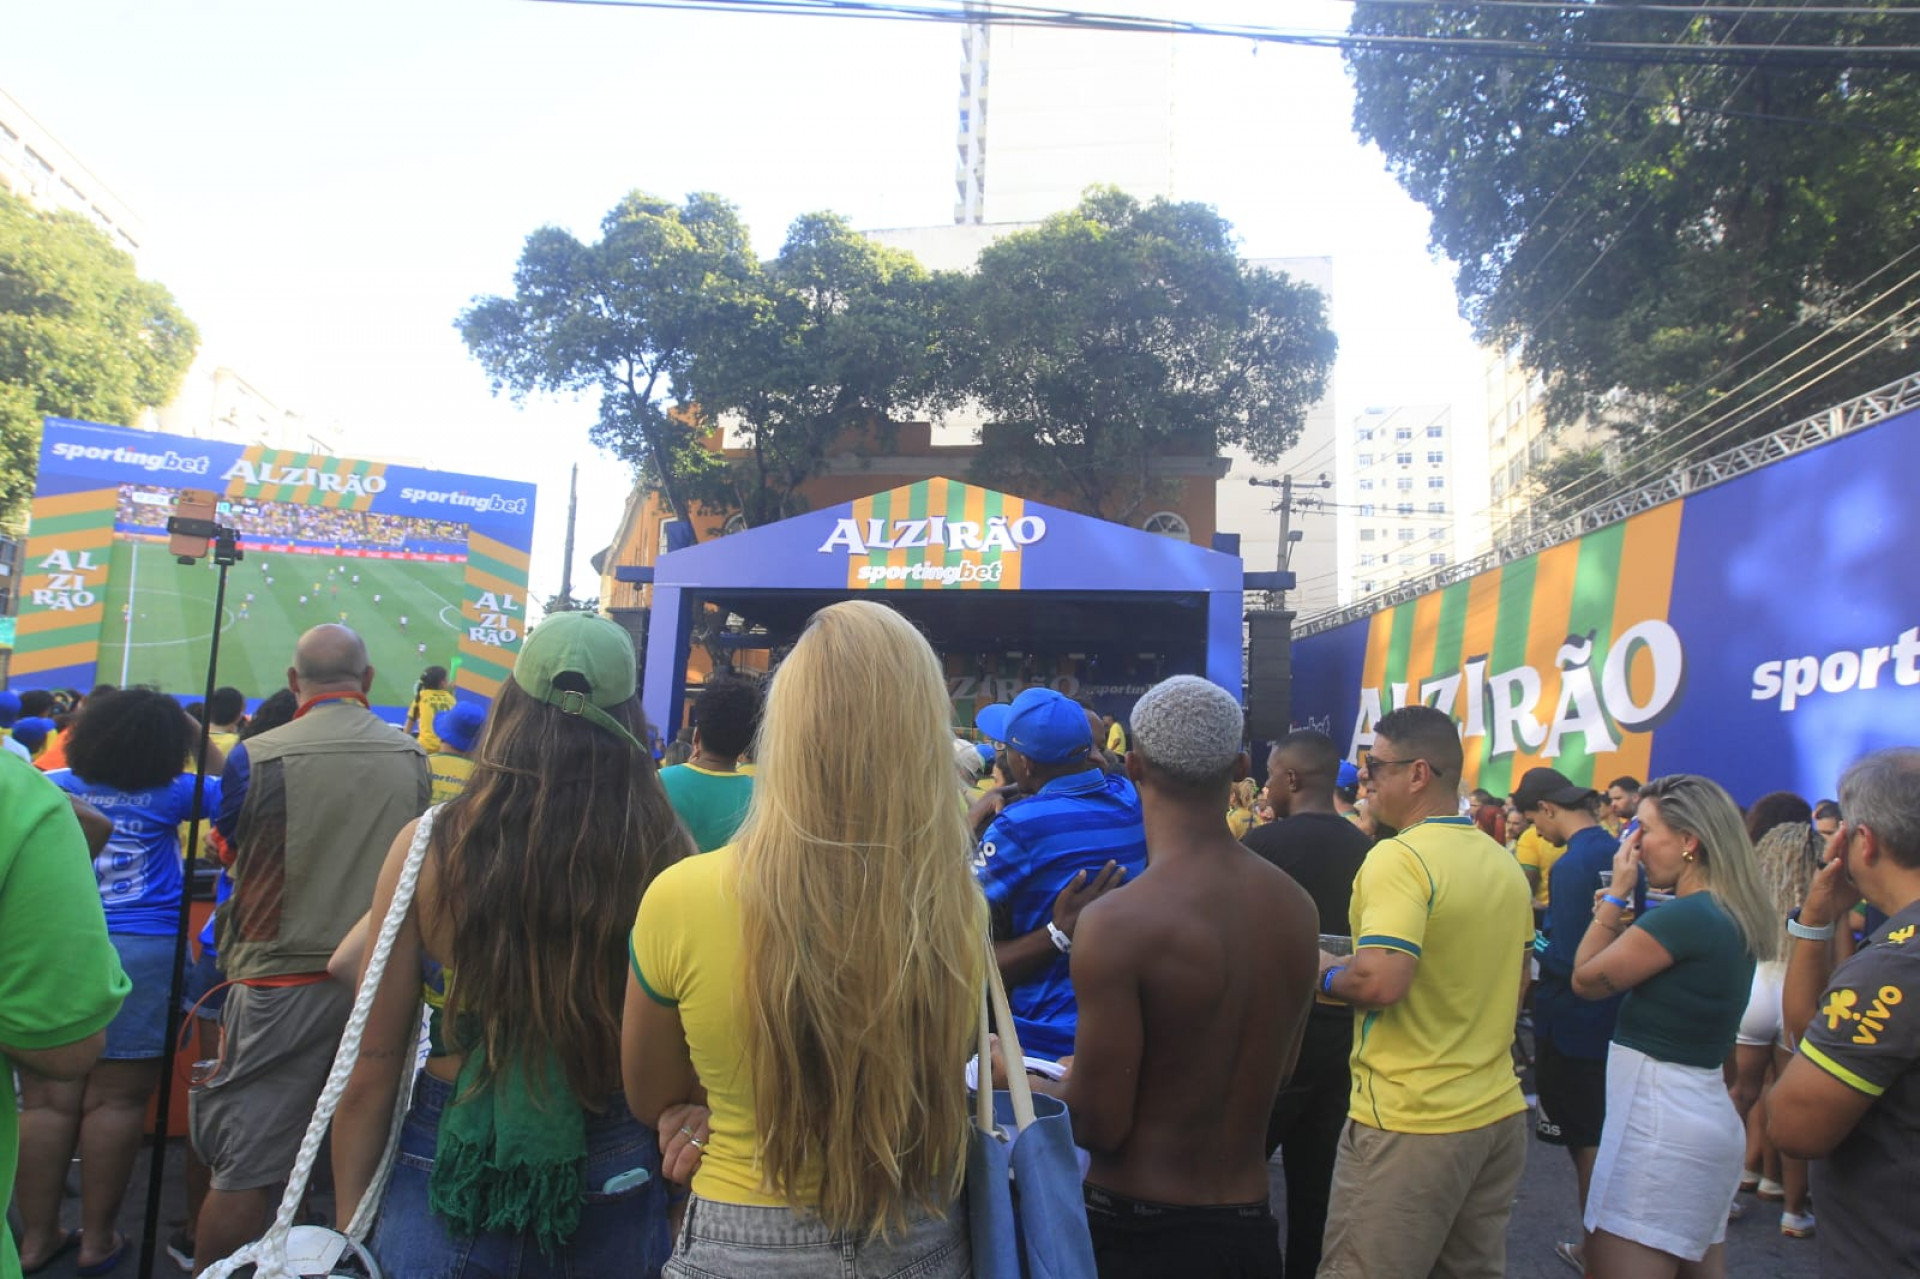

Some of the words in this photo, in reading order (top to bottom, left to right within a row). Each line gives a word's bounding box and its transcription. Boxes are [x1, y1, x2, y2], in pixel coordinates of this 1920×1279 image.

[51, 442, 210, 475] sportingbet
[220, 459, 387, 497] ALZIRÃO
[400, 487, 527, 515] sportingbet
[817, 515, 1046, 554] ALZIRÃO
[38, 548, 98, 572] AL
[857, 559, 1003, 584] sportingbet
[47, 573, 86, 590] ZI
[32, 589, 95, 612] RÃO
[473, 591, 518, 612] AL
[480, 613, 509, 628] ZI
[469, 626, 517, 646] RÃO
[1852, 985, 1903, 1045] vivo
